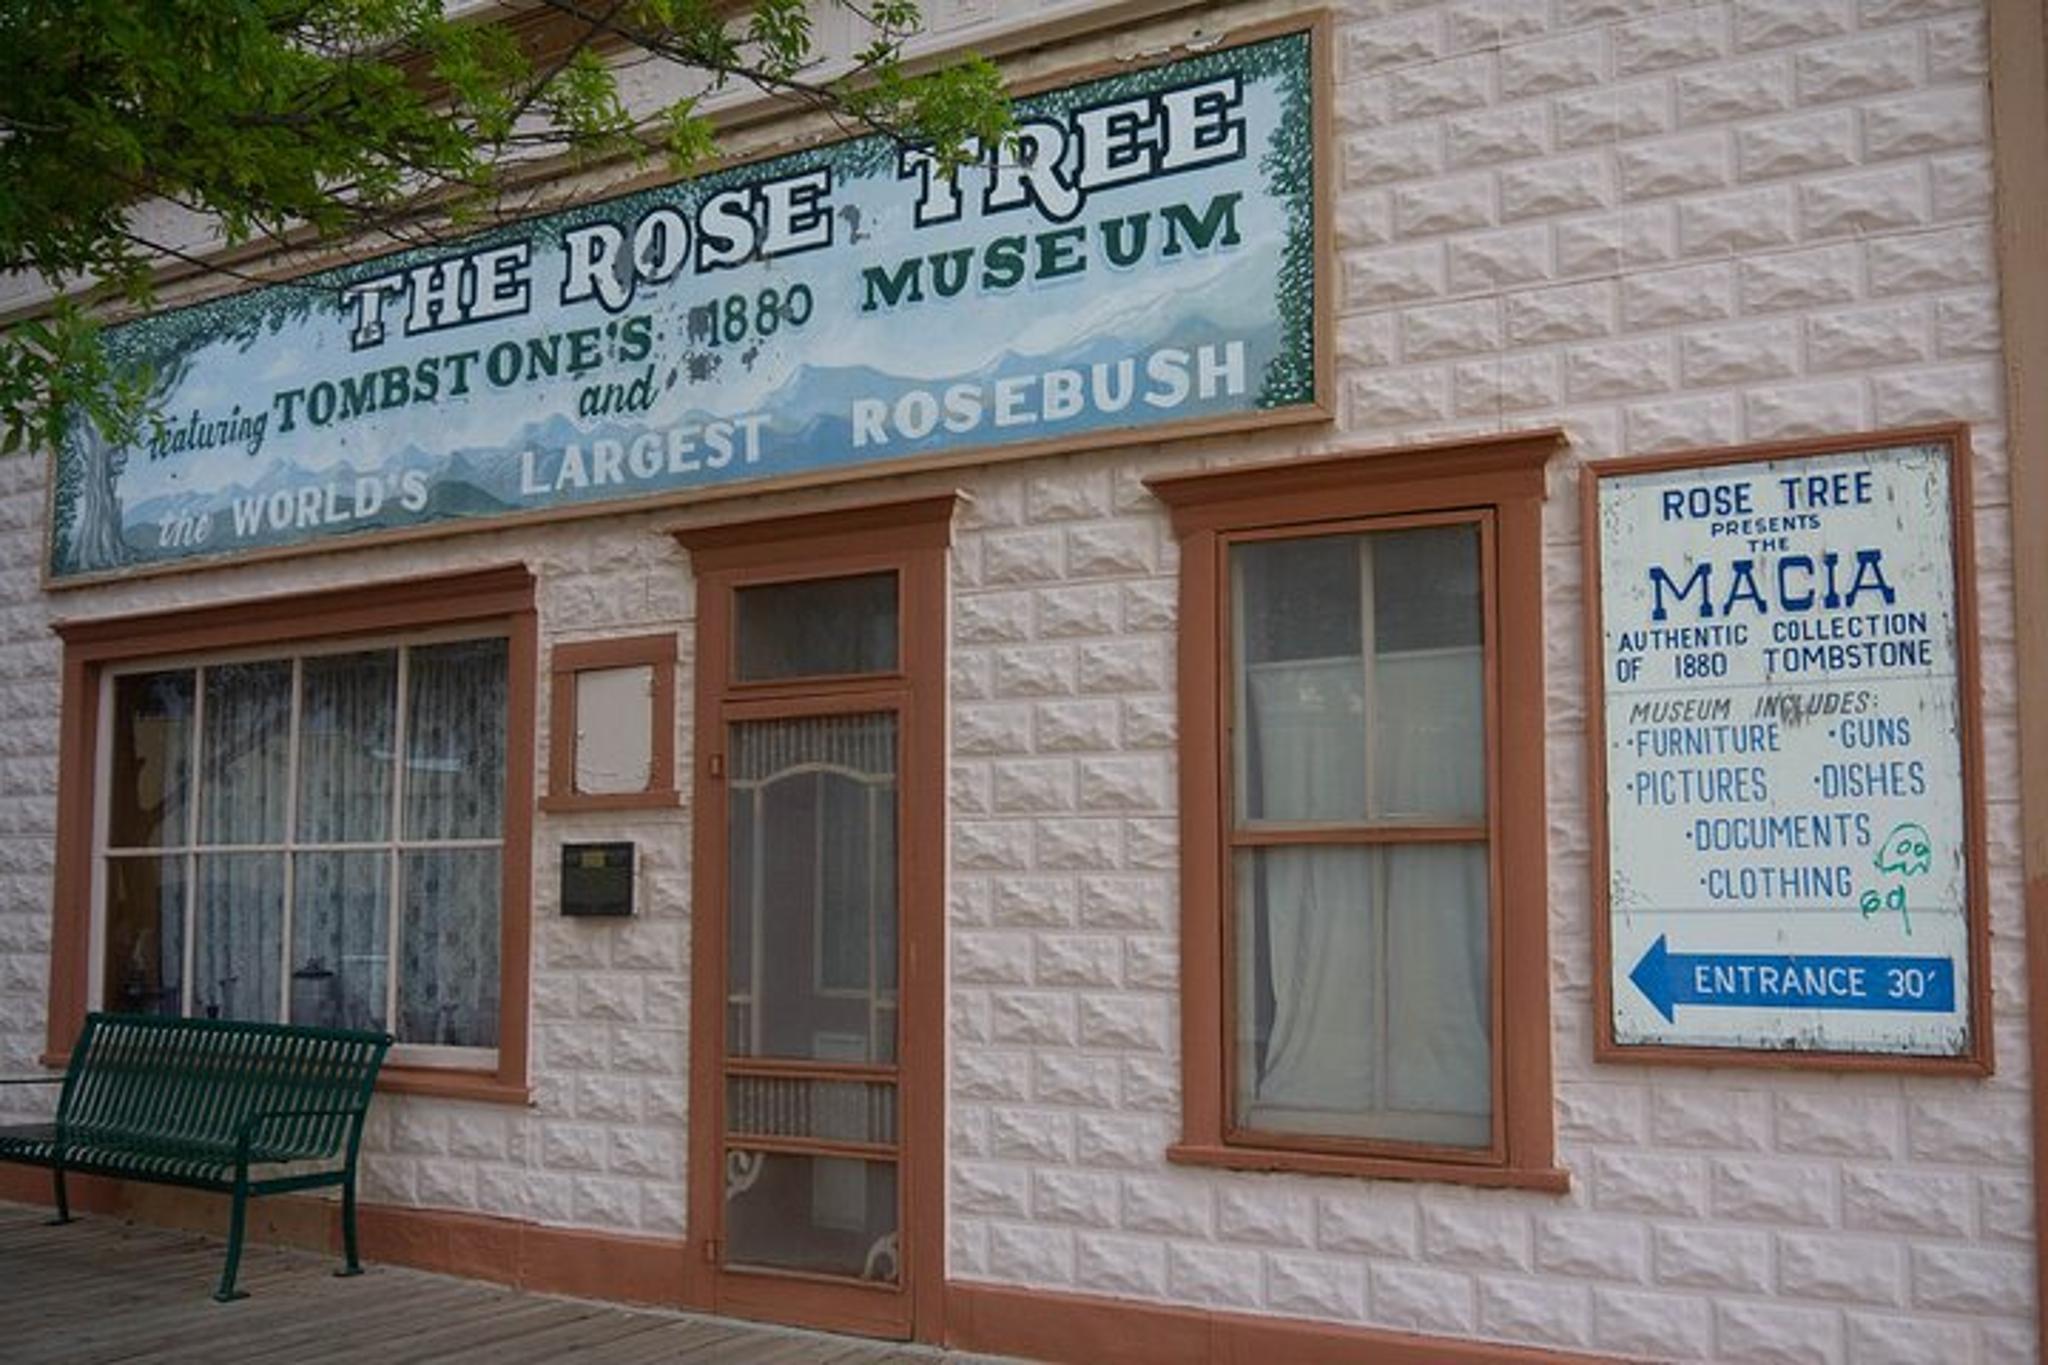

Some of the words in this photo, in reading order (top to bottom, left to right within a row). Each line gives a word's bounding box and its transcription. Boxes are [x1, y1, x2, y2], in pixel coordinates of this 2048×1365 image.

[343, 238, 532, 352] THE
[560, 166, 833, 313] ROSE
[898, 68, 1247, 228] TREE
[273, 314, 653, 434] TOMBSTONE'S
[706, 282, 813, 348] 1880
[861, 191, 1244, 312] MUSEUM
[579, 364, 658, 417] and
[158, 509, 211, 549] the
[232, 469, 429, 539] WORLD'S
[520, 412, 772, 495] LARGEST
[851, 340, 1246, 447] ROSEBUSH
[1662, 483, 1753, 521] ROSE
[1781, 471, 1873, 510] TREE
[1711, 514, 1821, 537] PRESENTS
[1747, 538, 1790, 553] THE
[1649, 549, 1896, 621] MACIA
[1618, 624, 1748, 652] AUTHENTIC
[1773, 612, 1928, 643] COLLECTION
[1617, 656, 1642, 683] OF
[1675, 652, 1727, 679] 1880
[1763, 640, 1933, 674] TOMBSTONE
[1629, 698, 1731, 725] MUSEUM
[1694, 965, 1866, 998] ENTRANCE
